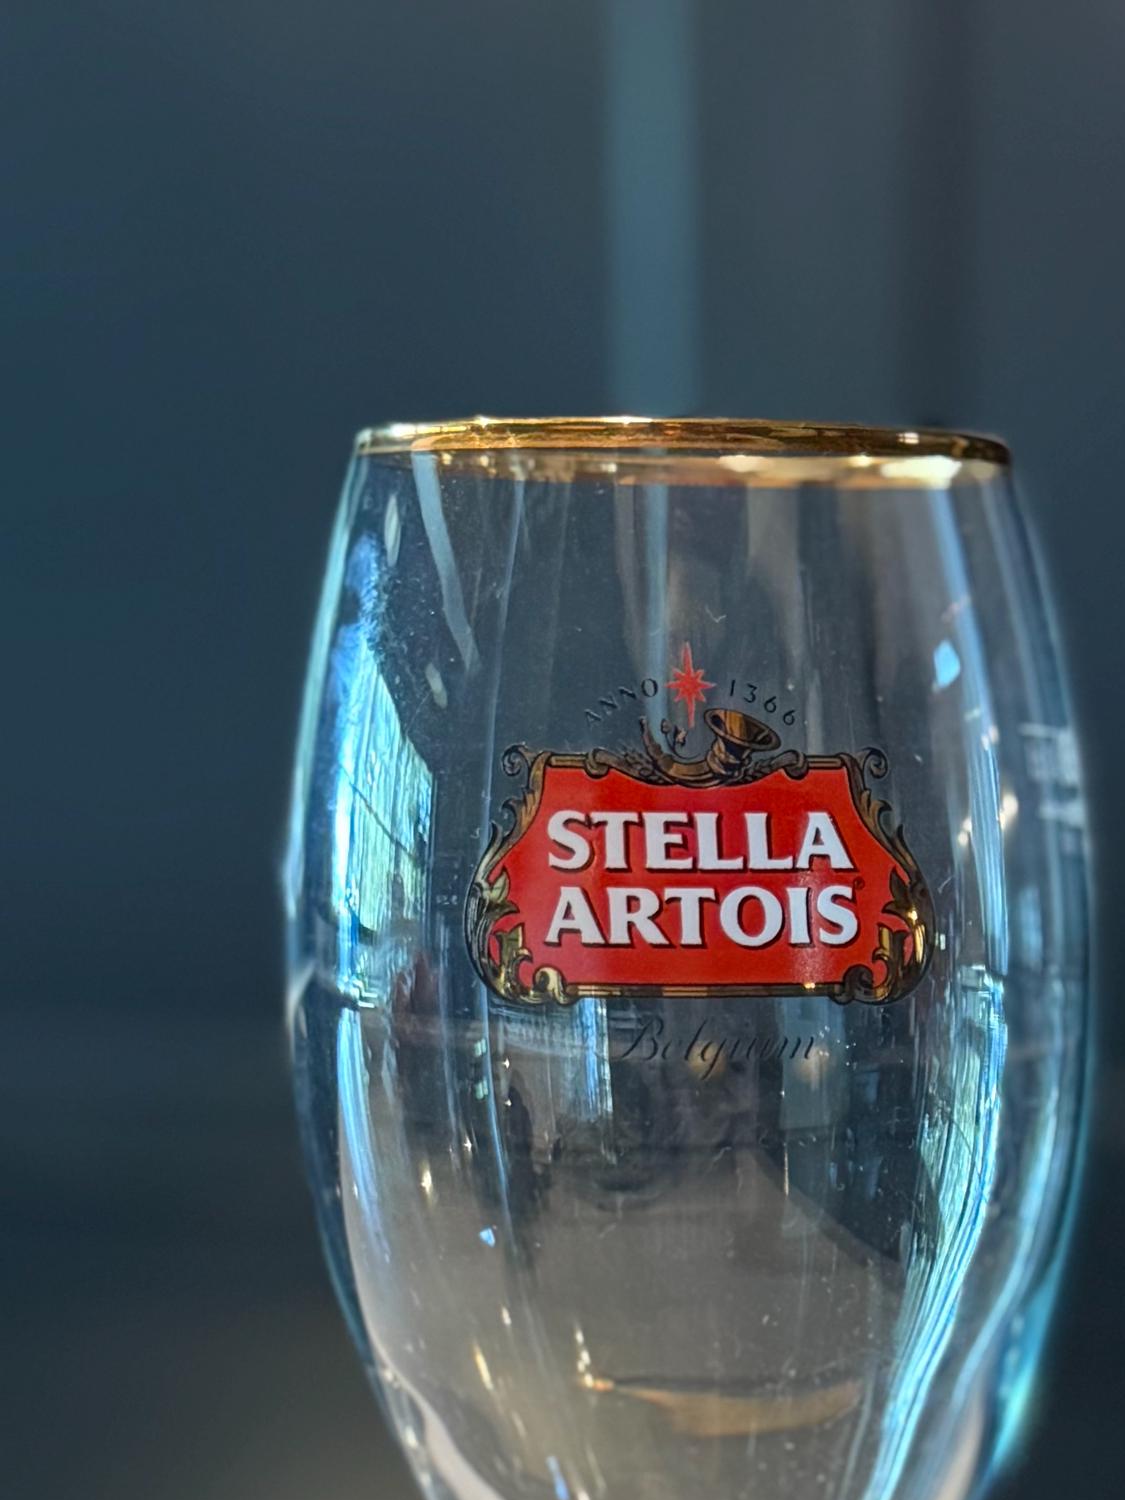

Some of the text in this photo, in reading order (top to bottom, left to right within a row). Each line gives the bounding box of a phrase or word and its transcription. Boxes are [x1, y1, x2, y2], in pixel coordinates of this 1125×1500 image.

[583, 678, 797, 728] ANNO 1366
[545, 809, 855, 872] STELLA
[544, 885, 859, 948] ARTOIS
[620, 1013, 815, 1081] Belgium
